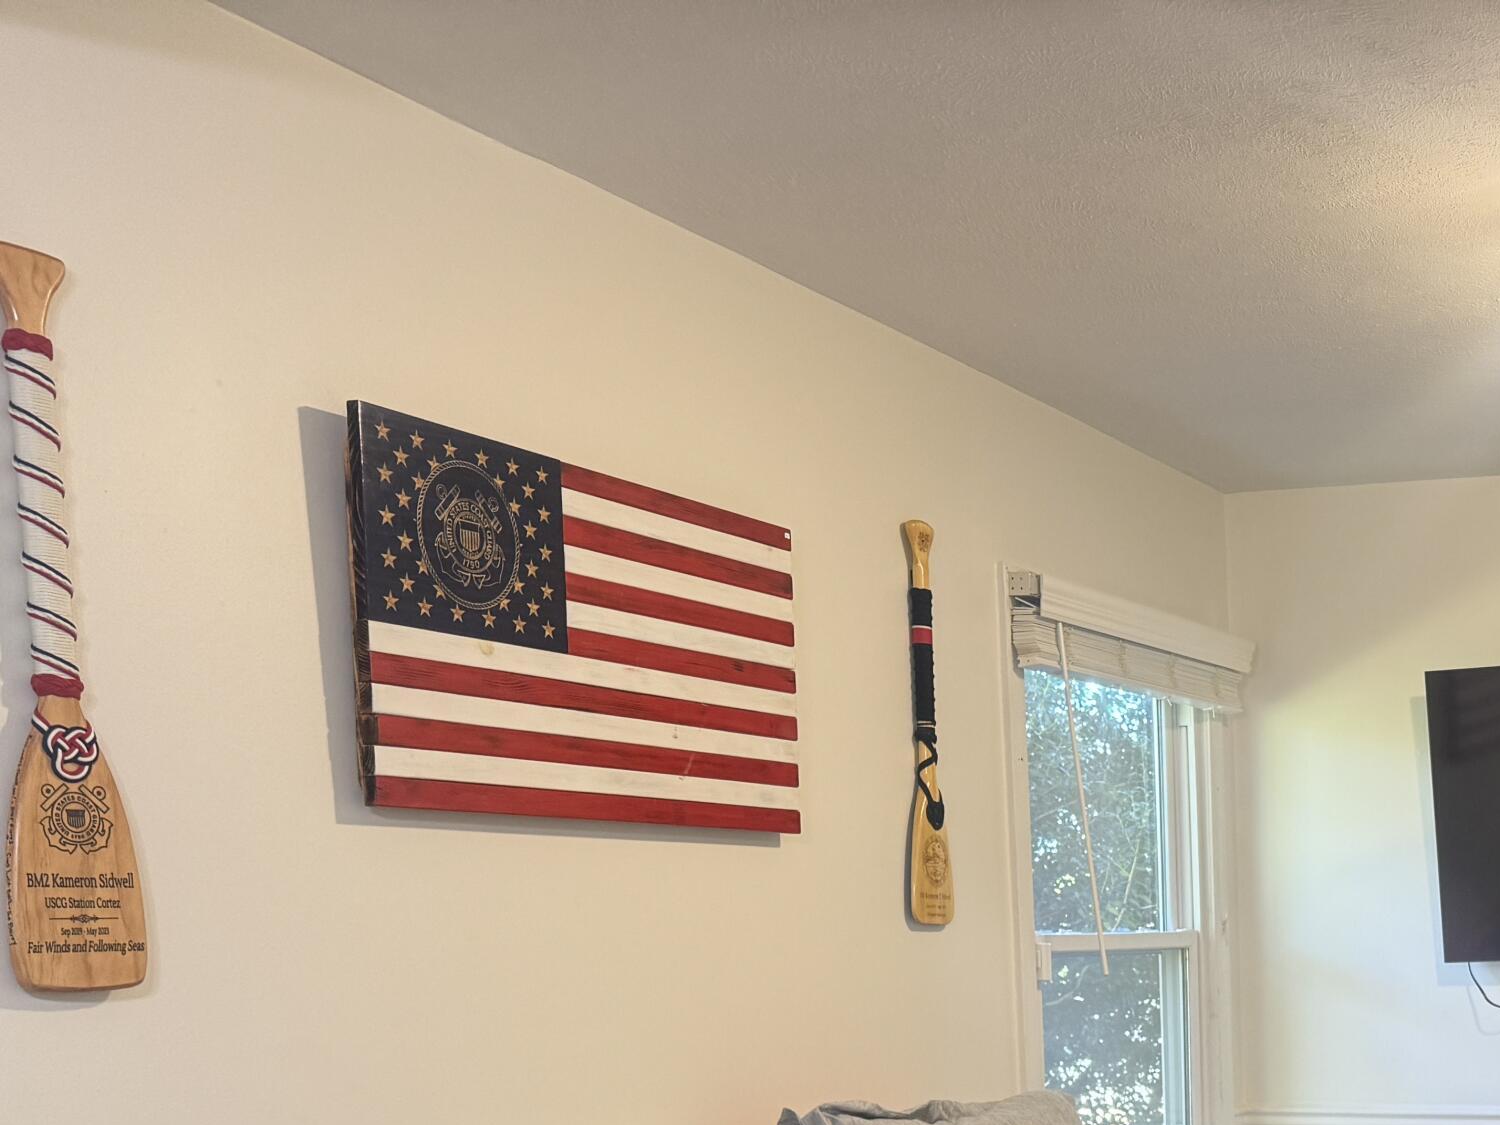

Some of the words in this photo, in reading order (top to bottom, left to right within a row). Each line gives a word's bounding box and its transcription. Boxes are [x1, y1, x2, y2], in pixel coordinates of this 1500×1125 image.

[449, 502, 470, 519] STATES
[470, 505, 489, 528] COAST
[446, 518, 457, 553] UNITED
[484, 530, 493, 560] GUARD
[462, 559, 480, 569] 1790
[56, 794, 76, 811] STATES
[77, 795, 96, 813] COAST
[54, 812, 70, 837] UNITED
[26, 872, 50, 888] BM2
[52, 873, 97, 888] Kameron
[99, 872, 134, 888] Sidwell
[44, 897, 68, 909] USCG
[69, 897, 96, 909] Station
[96, 897, 121, 909] Cortez
[60, 927, 71, 938] Sep
[86, 927, 97, 938] May
[27, 941, 44, 954] Fair
[45, 940, 71, 954] Winds
[71, 939, 87, 953] and
[88, 939, 127, 955] Following
[127, 939, 145, 952] Seas
